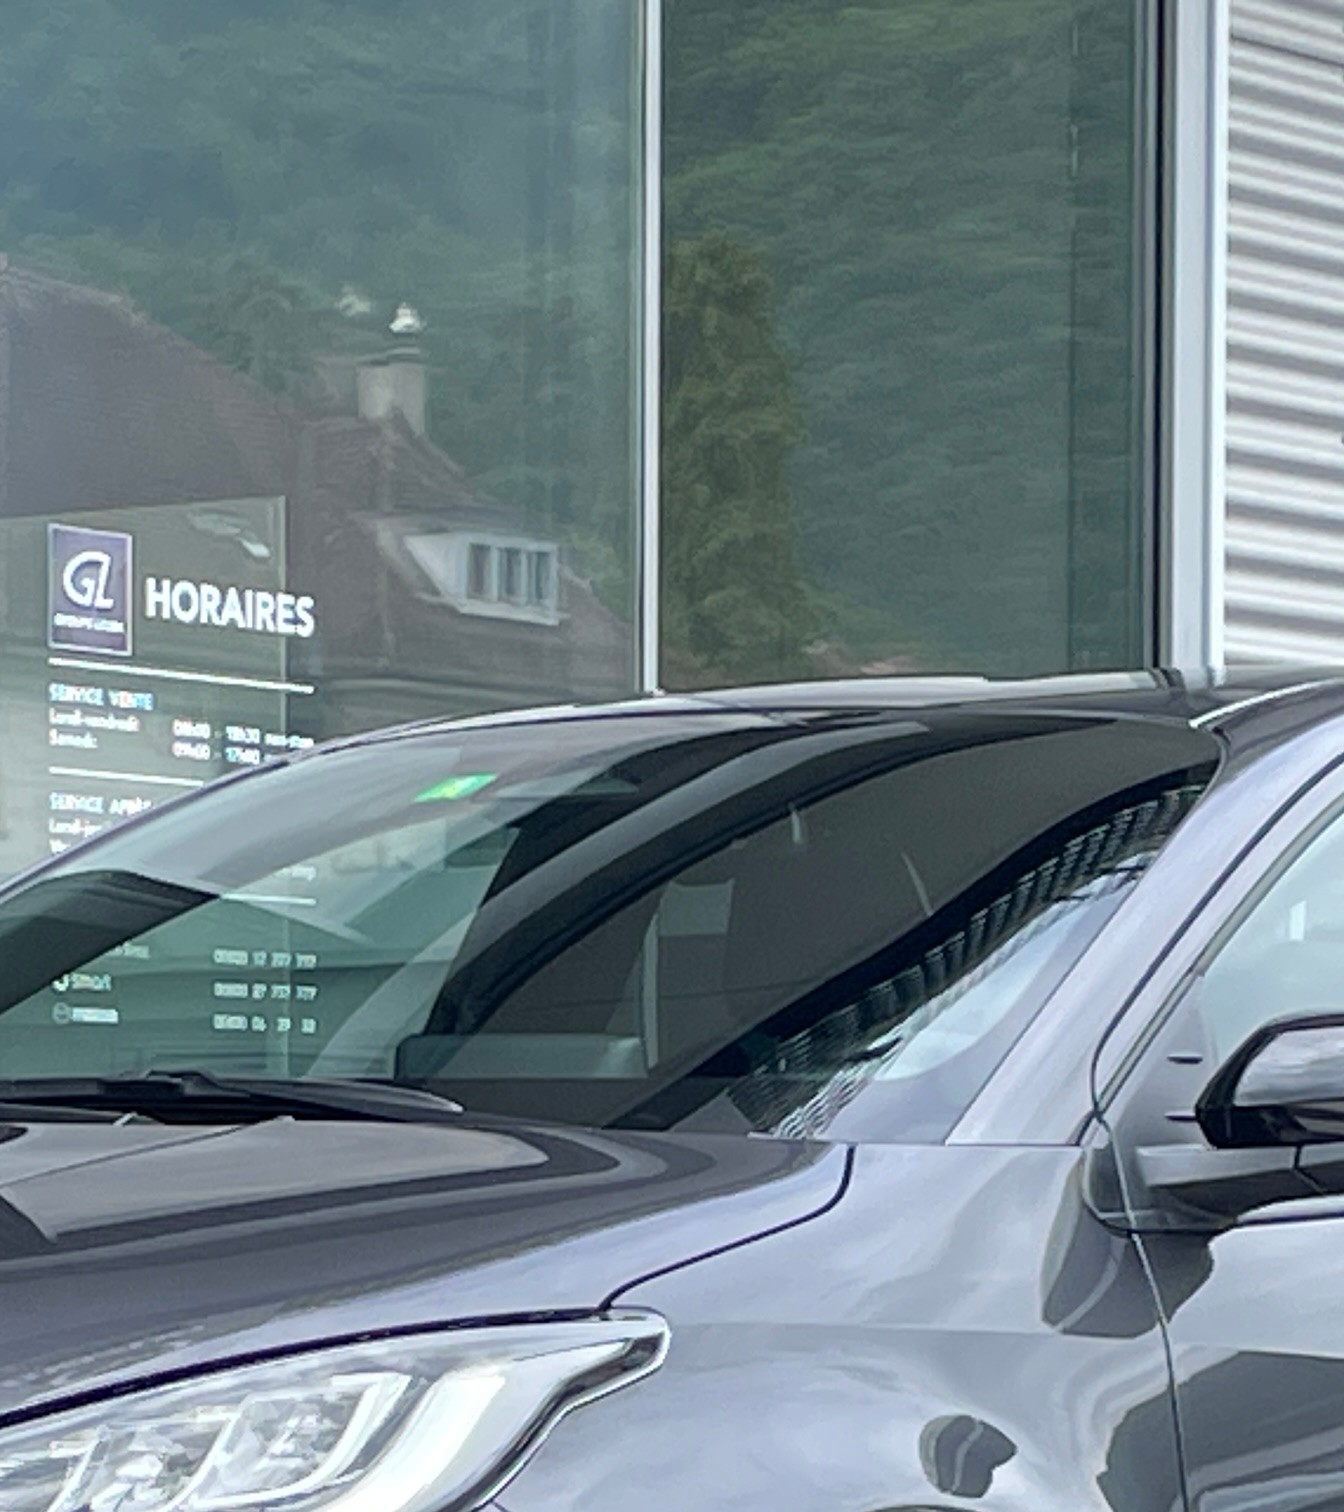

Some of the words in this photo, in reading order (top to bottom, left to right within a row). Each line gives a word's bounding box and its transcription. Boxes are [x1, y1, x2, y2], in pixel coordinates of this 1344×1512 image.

[145, 577, 316, 638] HORAIRES
[49, 683, 104, 707] SERVICE
[108, 688, 154, 711] VENTE
[49, 791, 104, 815] SERVICE
